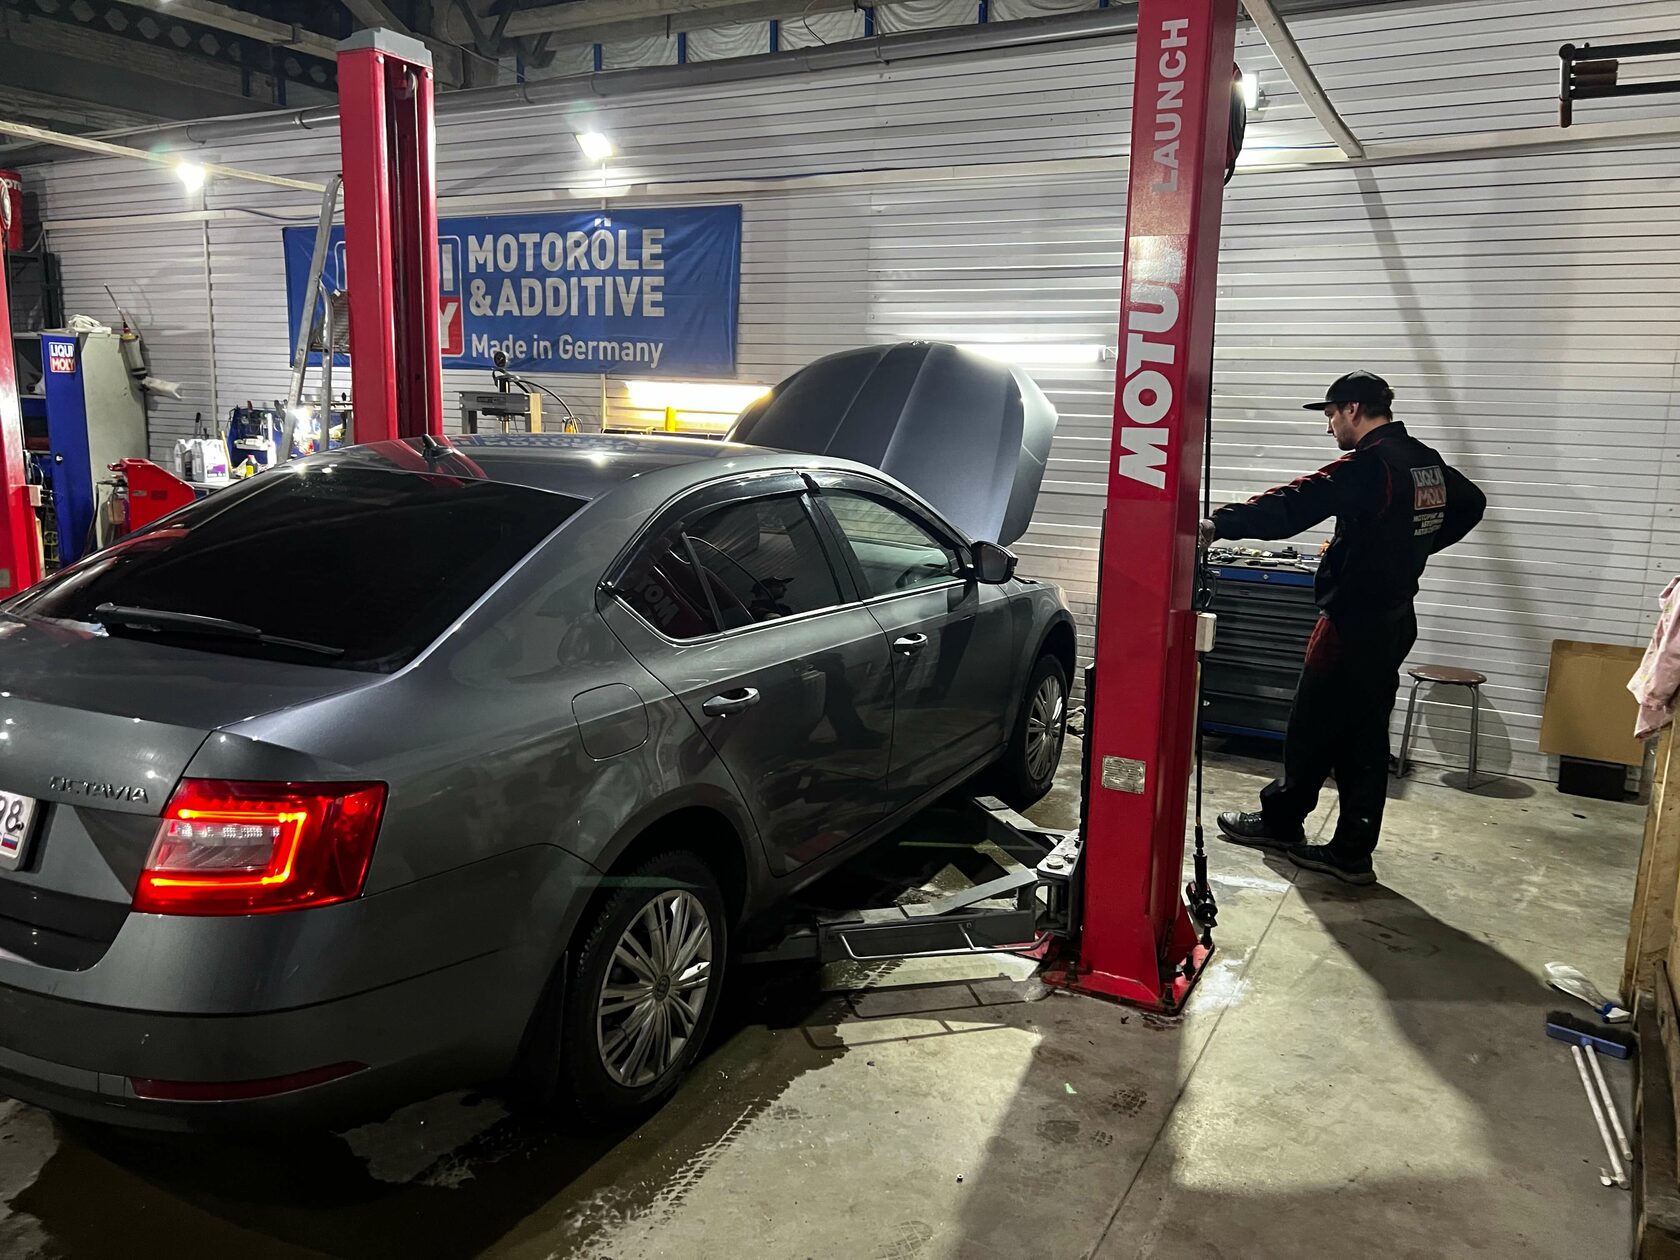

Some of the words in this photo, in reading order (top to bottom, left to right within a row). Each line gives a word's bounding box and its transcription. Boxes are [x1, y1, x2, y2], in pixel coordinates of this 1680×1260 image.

[1152, 18, 1189, 192] LAUNCH
[467, 217, 665, 273] MOTORÖLE
[468, 276, 665, 317] &ADDITIVE
[50, 344, 74, 357] LIQUI
[52, 357, 74, 371] MOLY
[471, 333, 526, 361] Made
[533, 334, 552, 360] in
[558, 334, 663, 369] Germany
[50, 776, 149, 804] OCTAVIA
